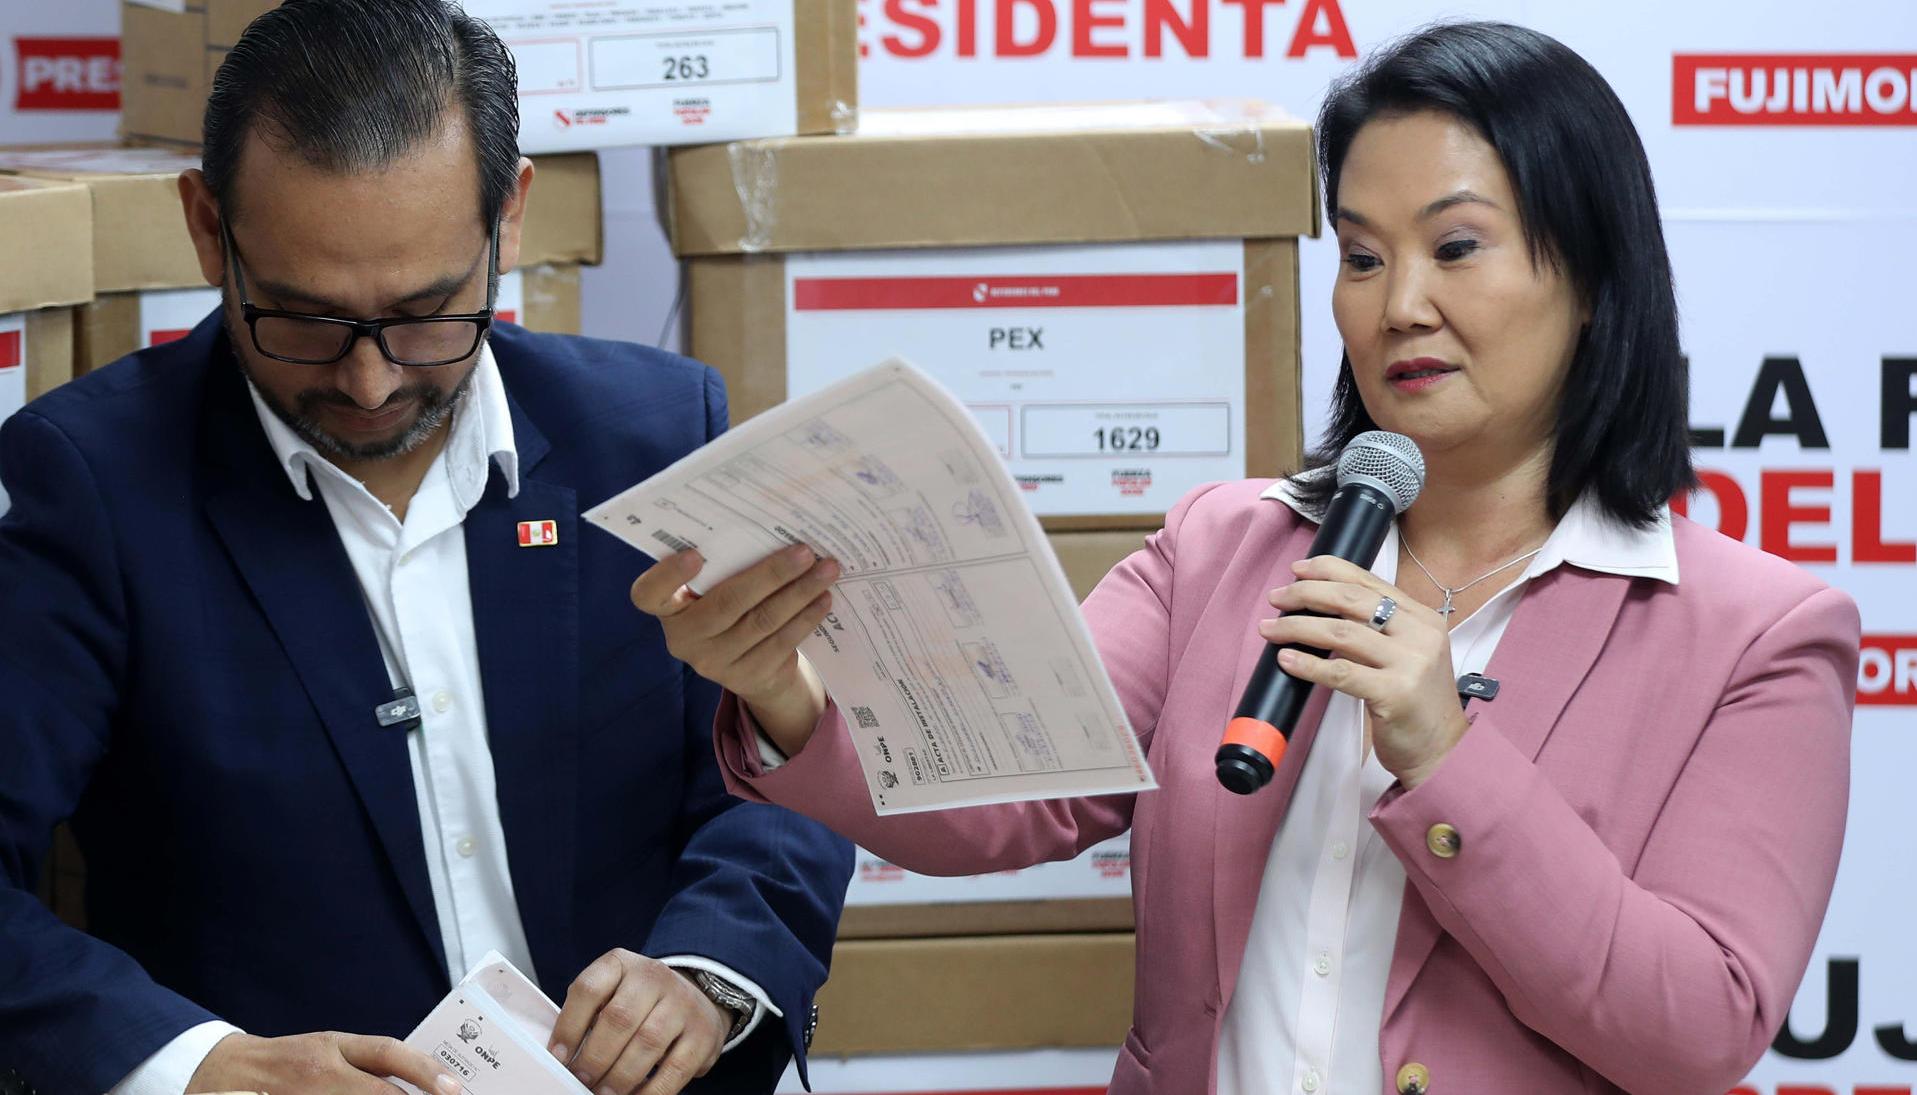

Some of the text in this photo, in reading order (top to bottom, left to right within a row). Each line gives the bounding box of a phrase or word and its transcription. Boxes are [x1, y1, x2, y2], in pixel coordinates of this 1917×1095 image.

[25, 56, 122, 92] PRE
[662, 56, 710, 81] 263
[1694, 66, 1917, 114] FUJIMO
[988, 328, 1045, 351] PEX
[1093, 426, 1161, 451] 1629
[877, 736, 892, 763] ONPE
[440, 1050, 470, 1076] 030716
[474, 1045, 501, 1070] ONPE
